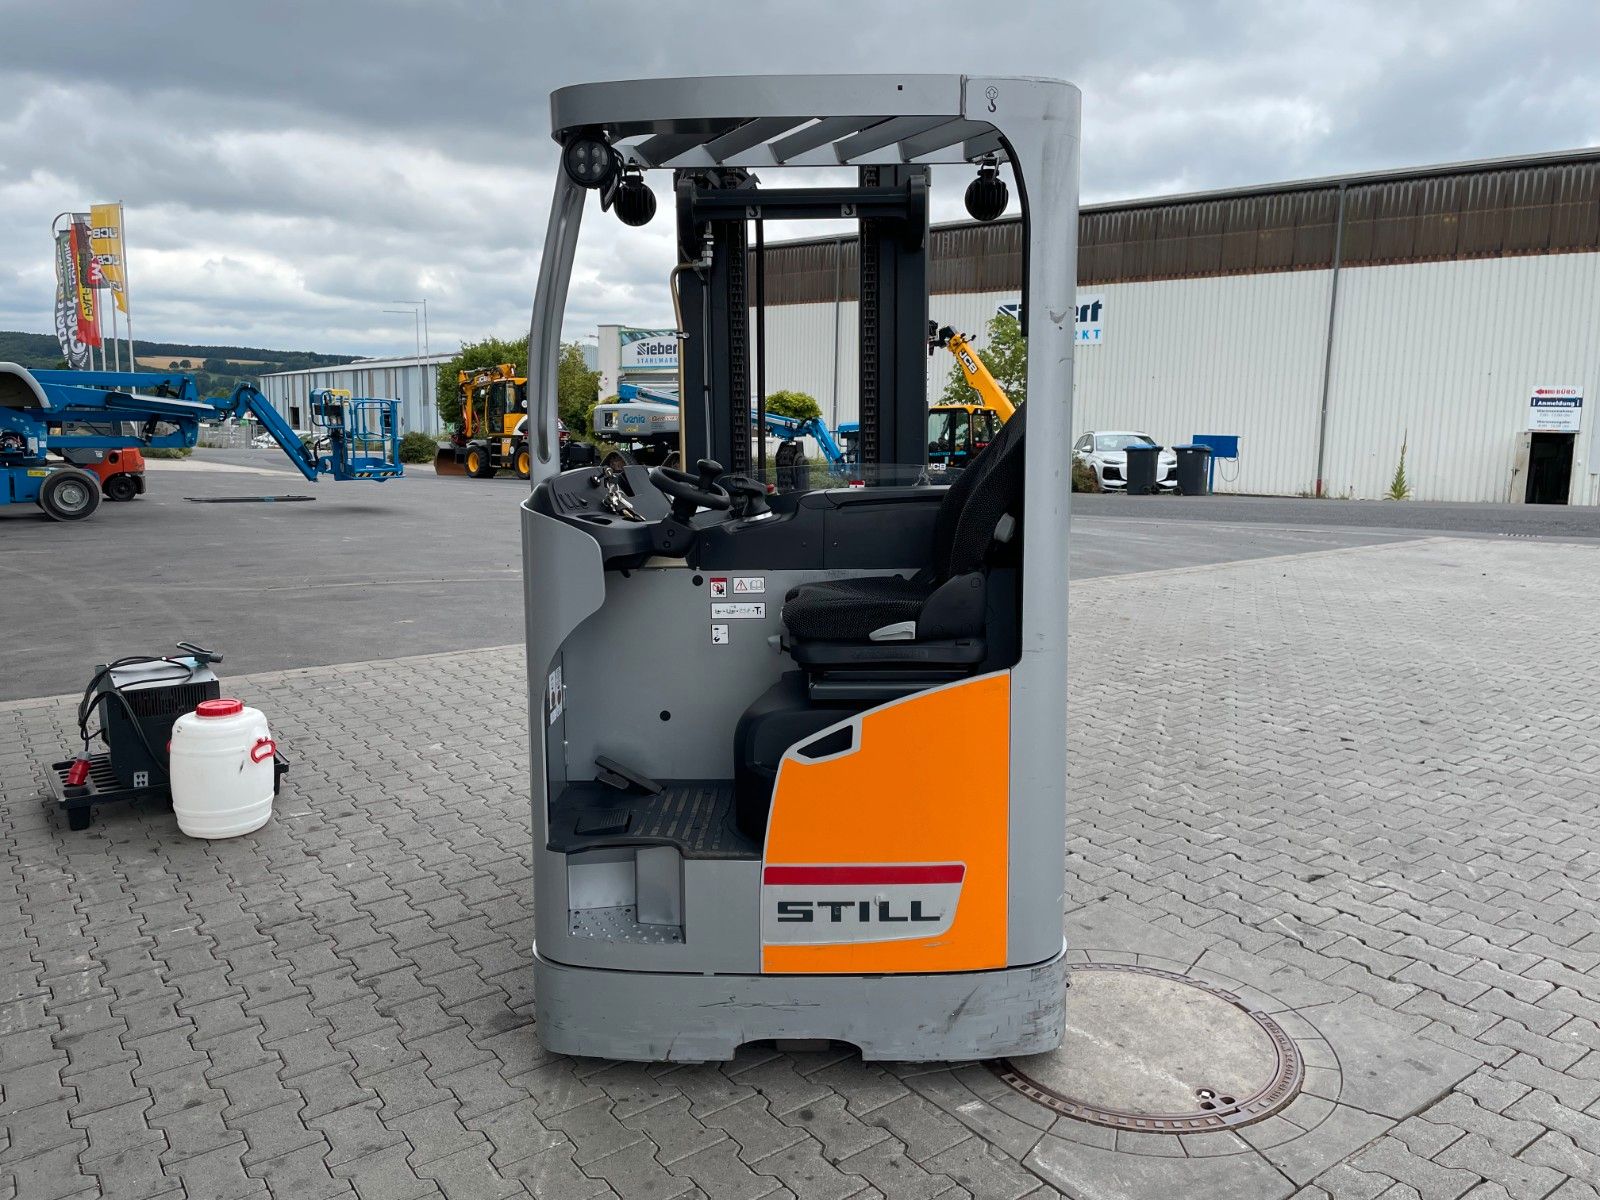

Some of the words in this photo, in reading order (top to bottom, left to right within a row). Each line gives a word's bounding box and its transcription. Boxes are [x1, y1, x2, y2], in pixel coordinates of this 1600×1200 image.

[958, 351, 978, 374] JCB
[623, 413, 646, 423] Genie
[777, 900, 941, 922] STILL
